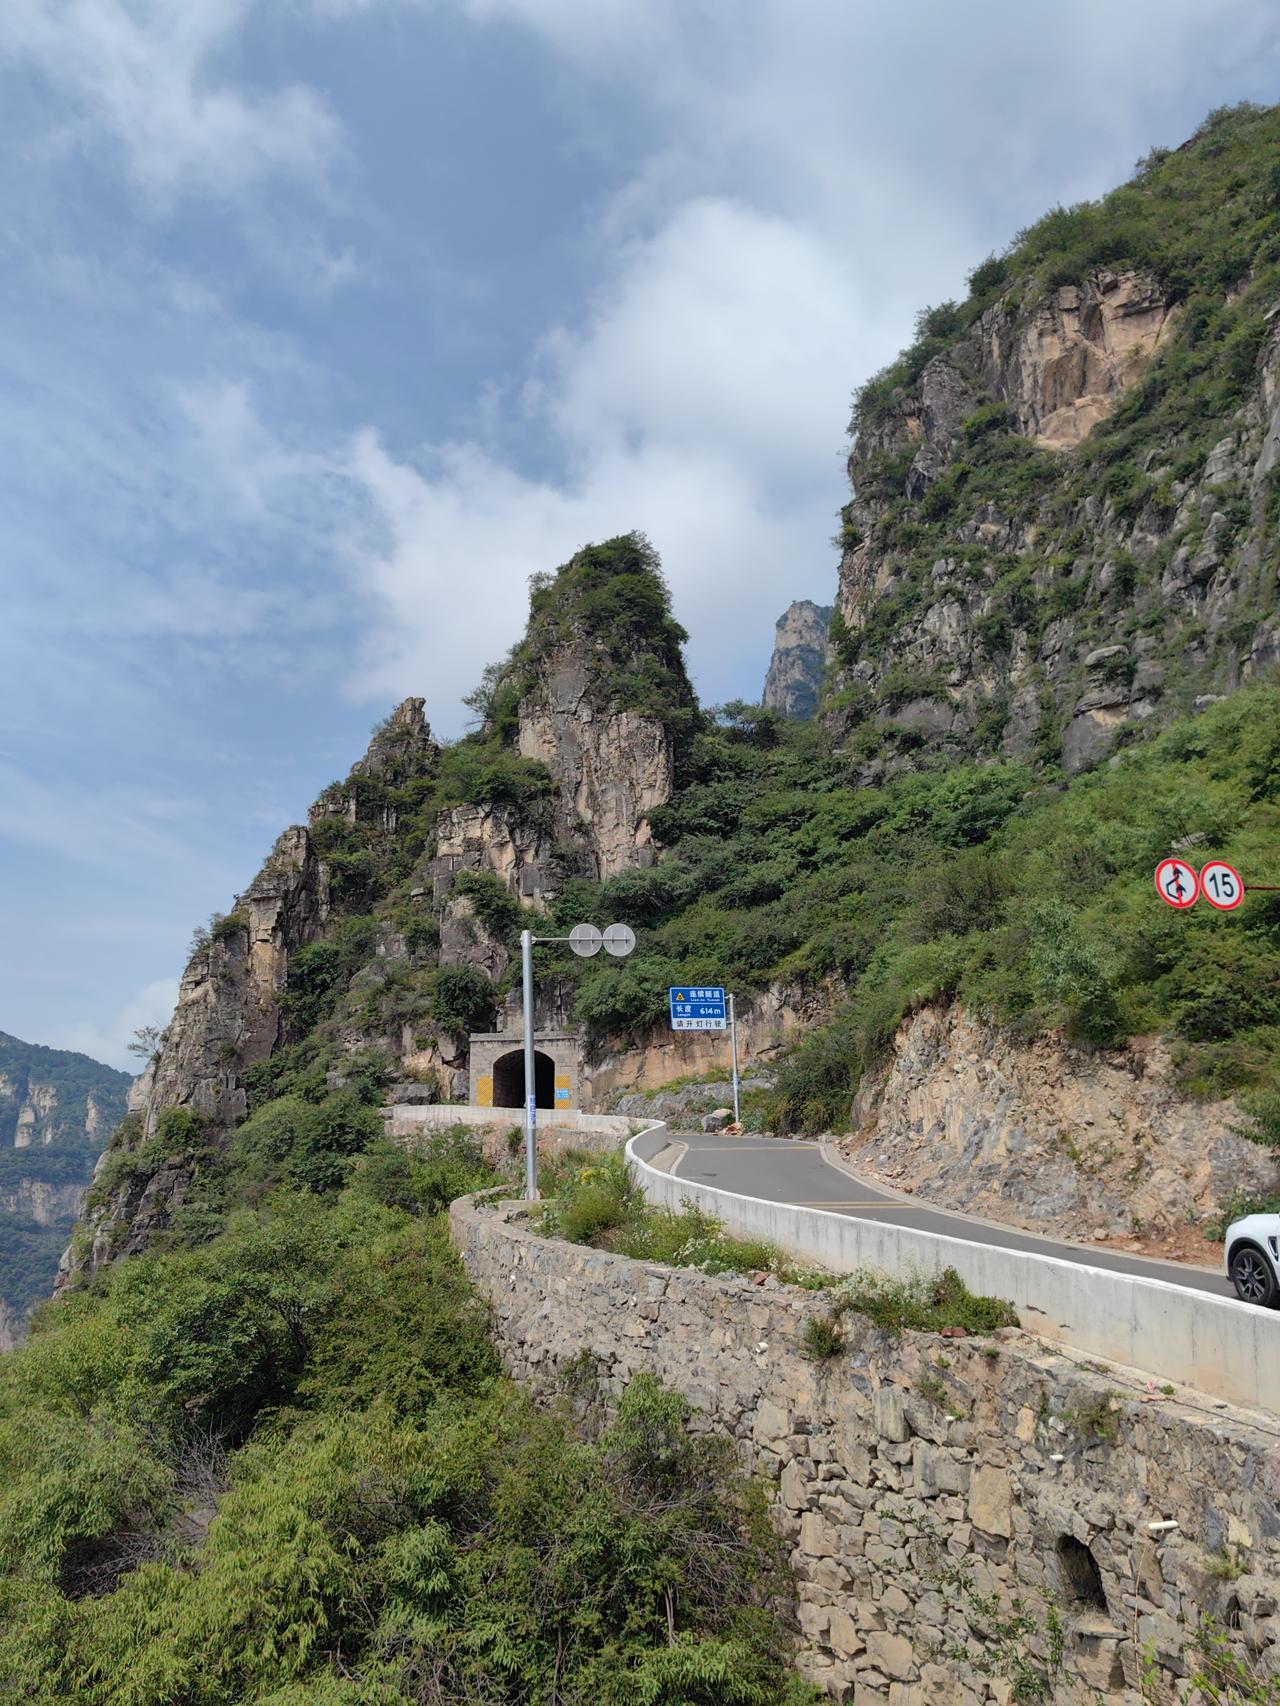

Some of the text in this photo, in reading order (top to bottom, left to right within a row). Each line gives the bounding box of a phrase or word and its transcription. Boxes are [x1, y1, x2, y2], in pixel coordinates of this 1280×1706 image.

[1209, 872, 1235, 898] 15
[689, 990, 720, 998] 连续隧道
